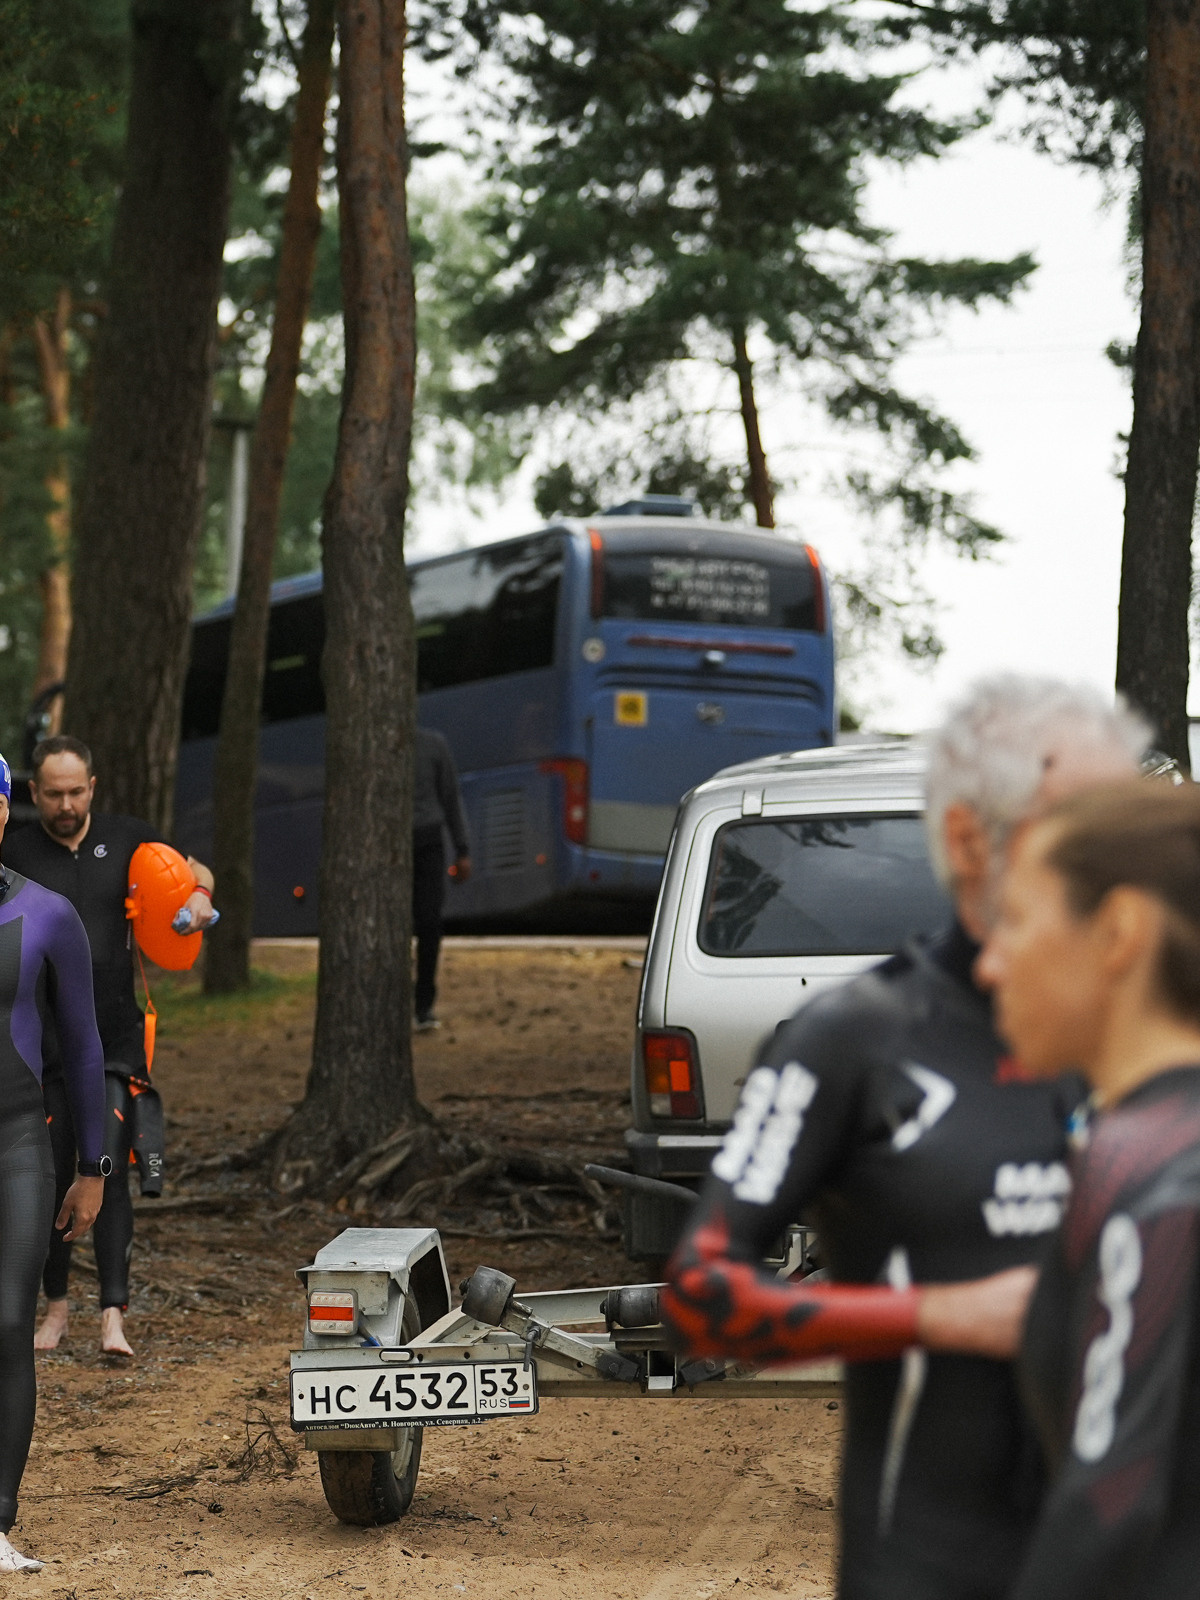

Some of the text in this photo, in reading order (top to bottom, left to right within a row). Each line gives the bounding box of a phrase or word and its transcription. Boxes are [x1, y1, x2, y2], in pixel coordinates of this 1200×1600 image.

[369, 1372, 469, 1412] 4532
[480, 1367, 519, 1397] 53
[480, 1398, 508, 1409] RUS
